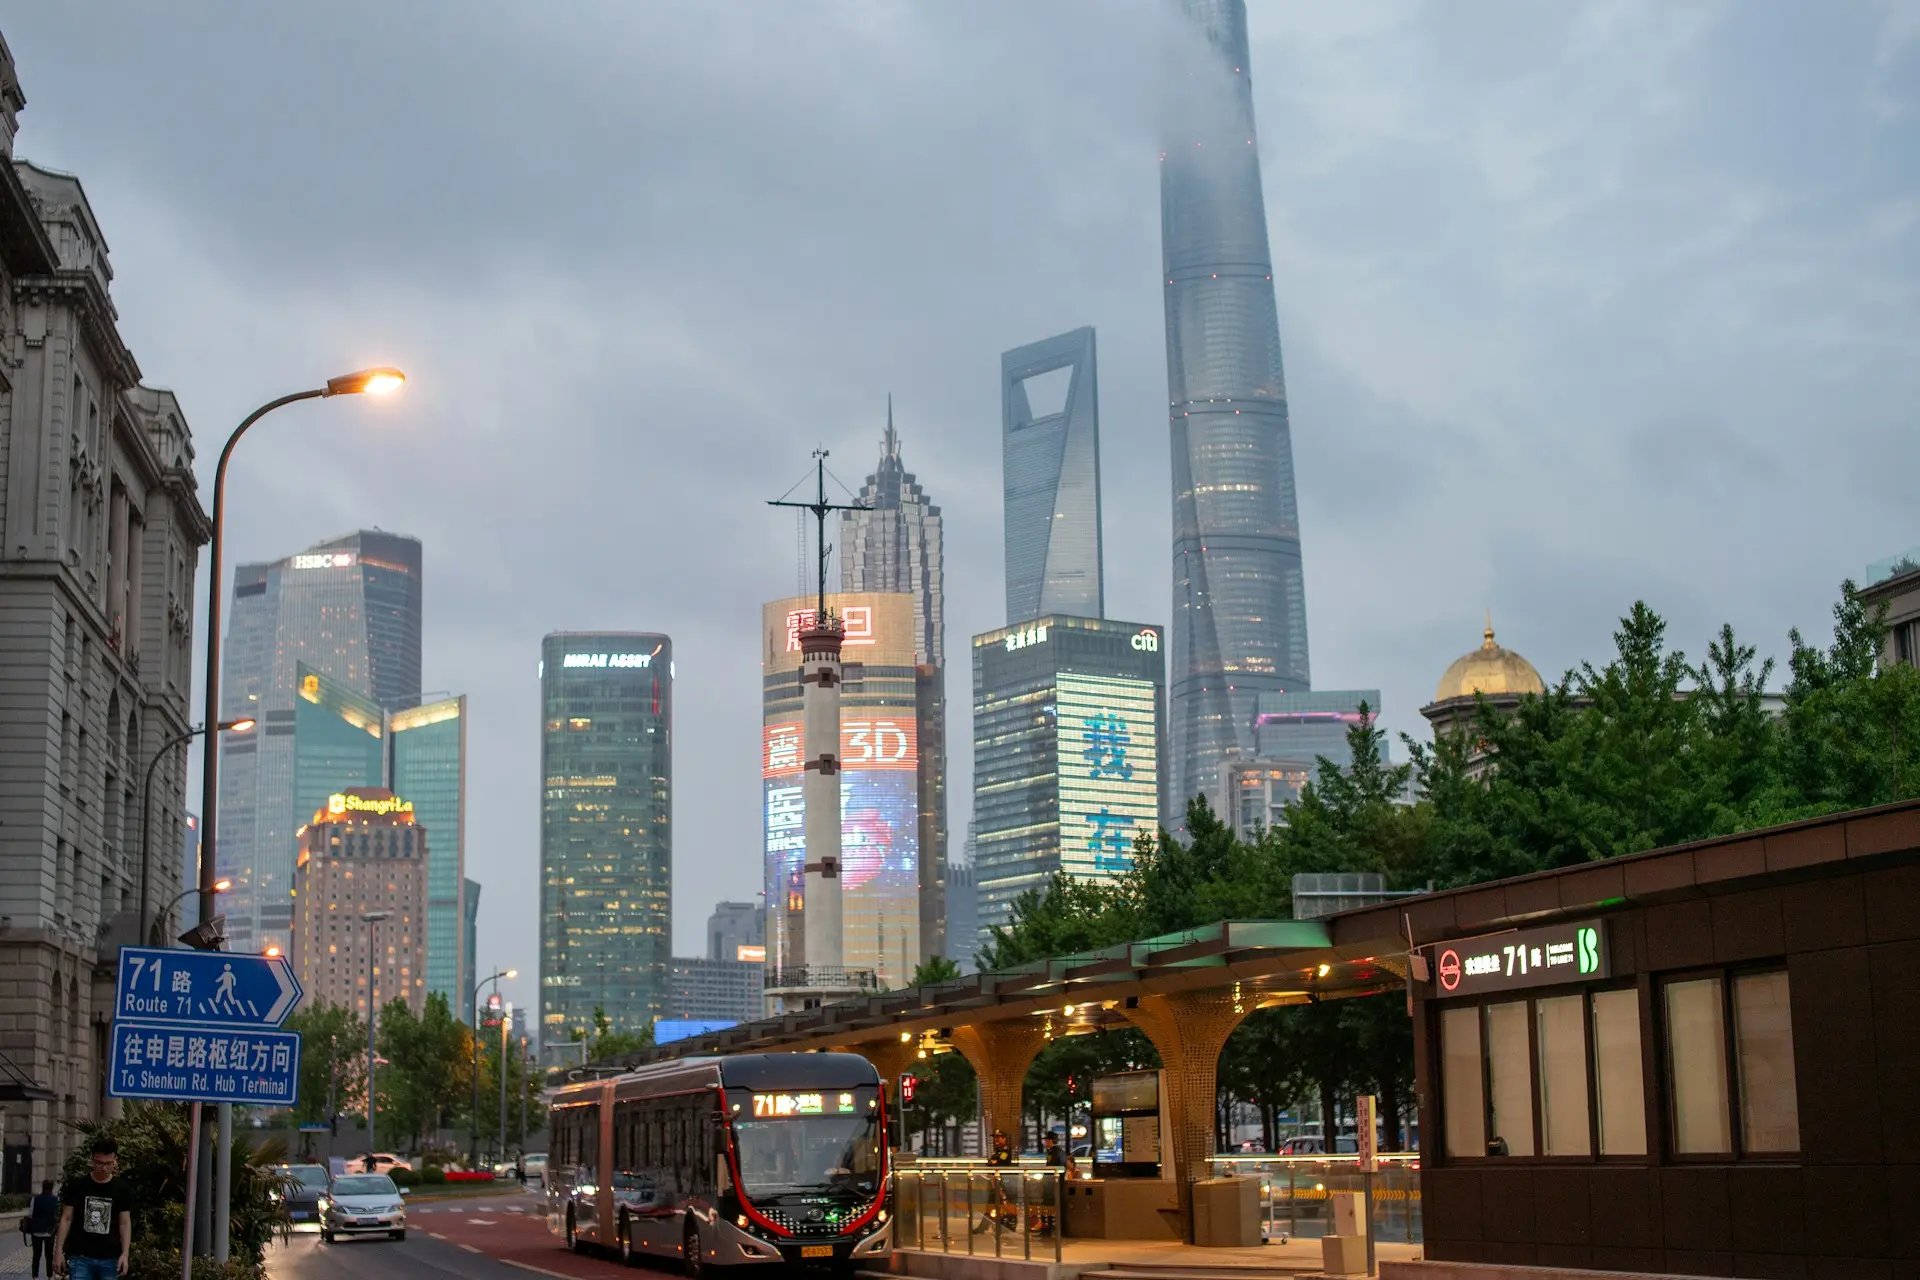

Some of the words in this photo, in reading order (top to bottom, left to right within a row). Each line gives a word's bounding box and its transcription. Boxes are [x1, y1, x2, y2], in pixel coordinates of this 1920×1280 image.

[295, 553, 333, 570] HSBC
[608, 653, 653, 668] ASSET
[841, 721, 908, 764] 3D
[125, 994, 168, 1014] Route
[177, 996, 192, 1015] 71
[123, 1032, 291, 1074] 往申昆路枢纽方向
[121, 1070, 135, 1088] To
[140, 1070, 187, 1090] Shenkun
[191, 1072, 210, 1091] Rd.
[215, 1074, 236, 1093] Hub
[242, 1075, 288, 1096] Terminal
